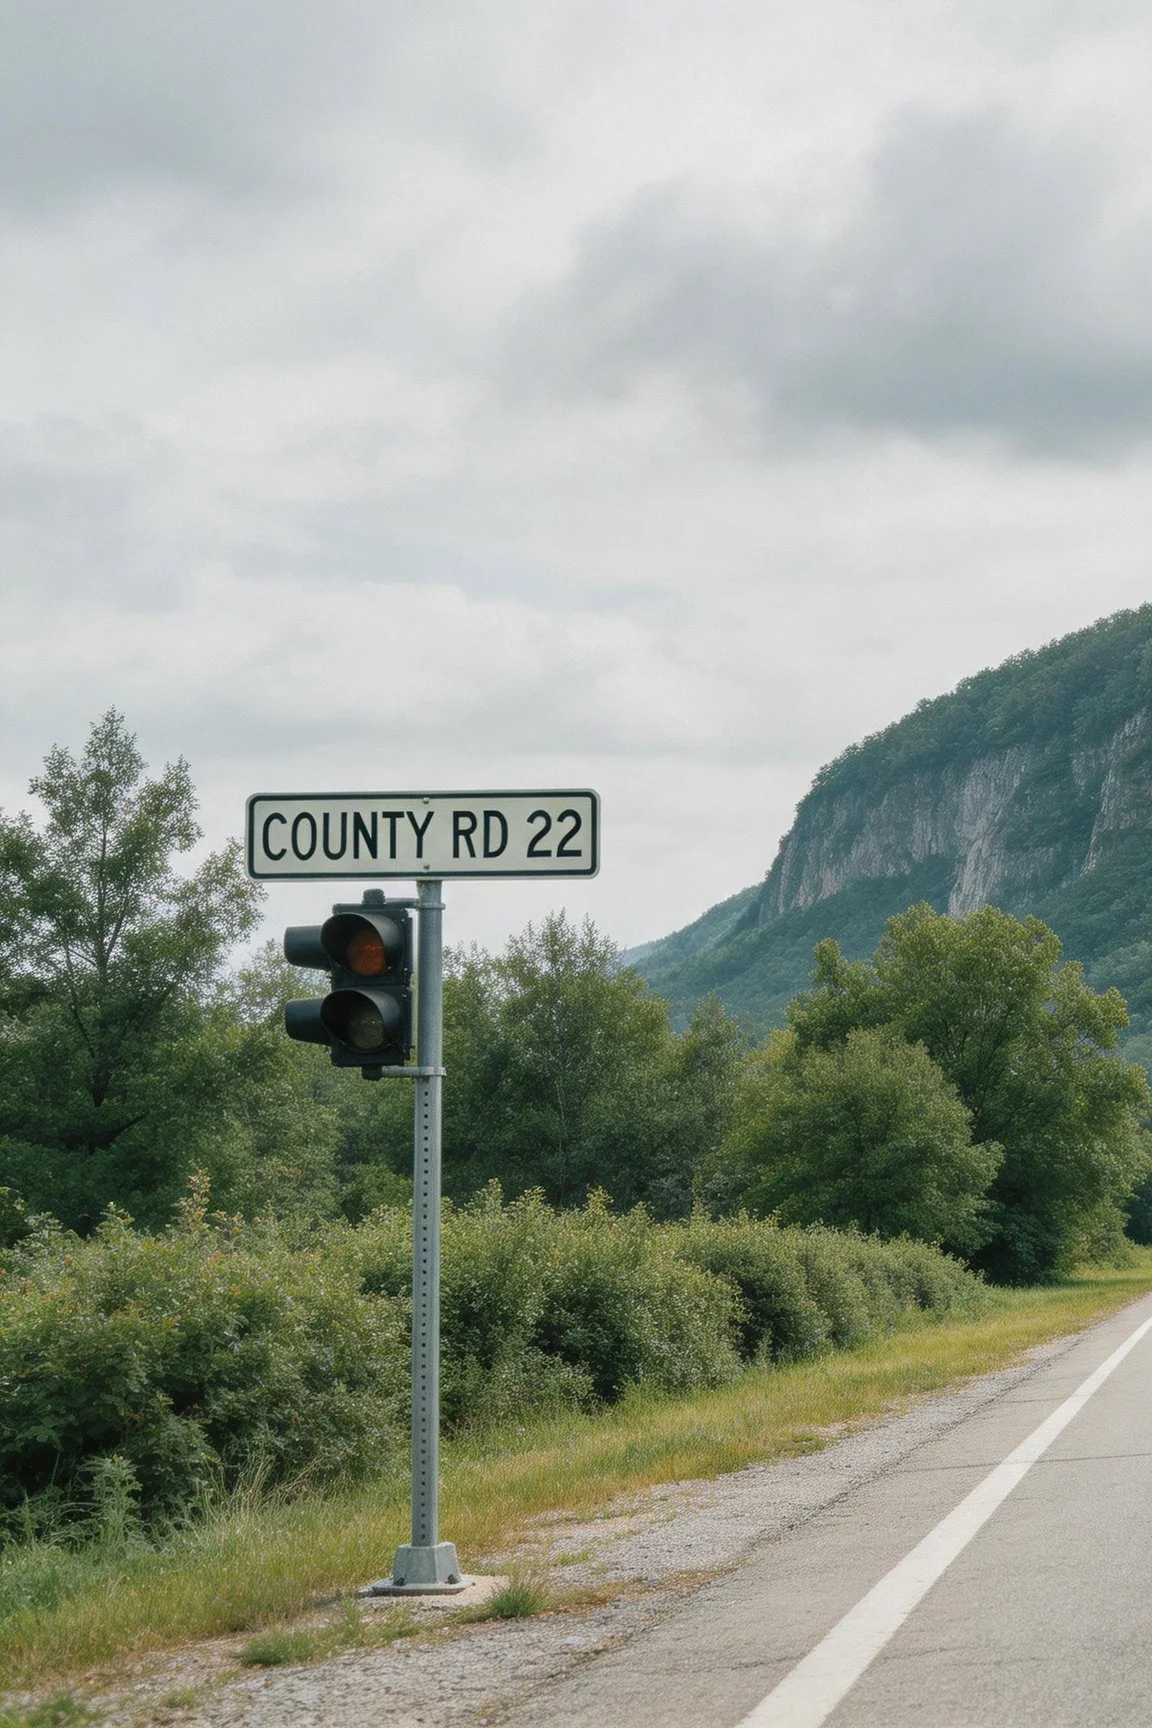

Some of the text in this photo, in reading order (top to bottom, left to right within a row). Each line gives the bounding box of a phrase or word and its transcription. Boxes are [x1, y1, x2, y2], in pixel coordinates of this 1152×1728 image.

[262, 808, 583, 861] COUNTY RD 22
